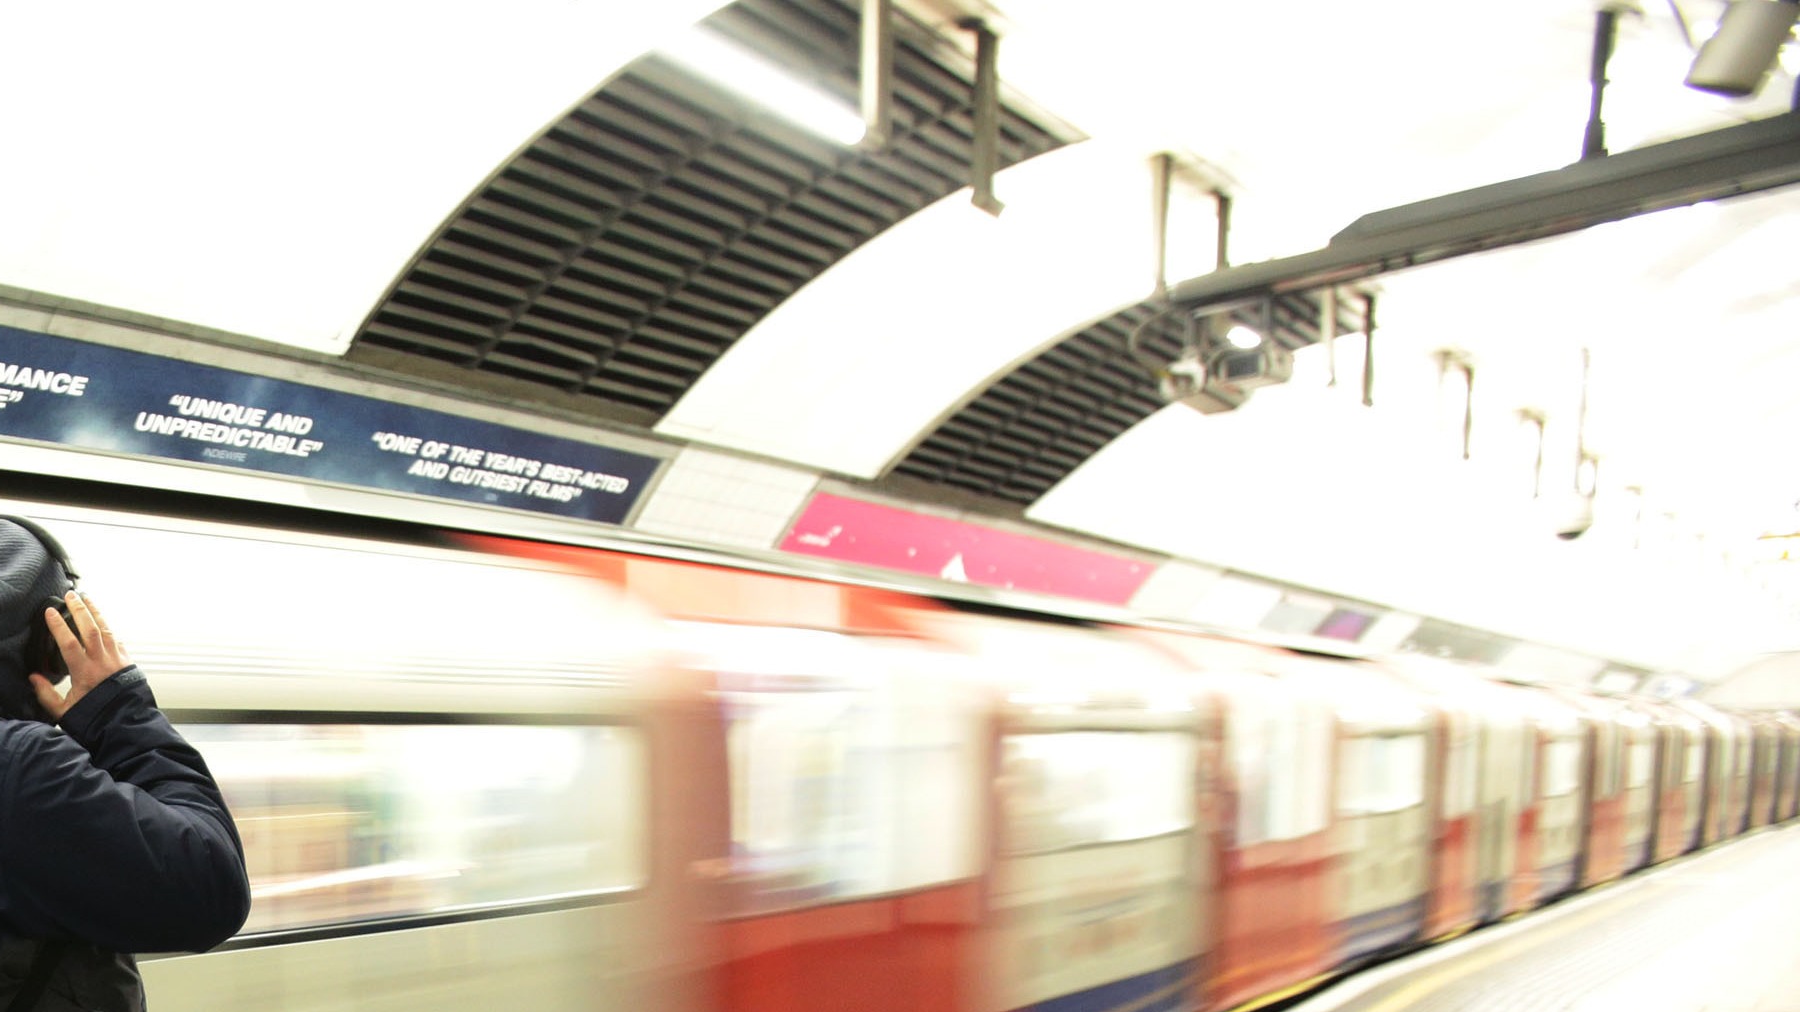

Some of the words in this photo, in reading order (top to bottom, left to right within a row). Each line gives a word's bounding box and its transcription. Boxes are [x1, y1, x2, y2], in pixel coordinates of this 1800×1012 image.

[263, 412, 313, 435] AND
[407, 459, 450, 480] AND
[450, 466, 530, 494] GUTSIEST
[420, 440, 449, 458] OF
[448, 445, 484, 467] THE
[483, 452, 542, 477] YEAR'S
[540, 463, 629, 494] BEST-ACTED
